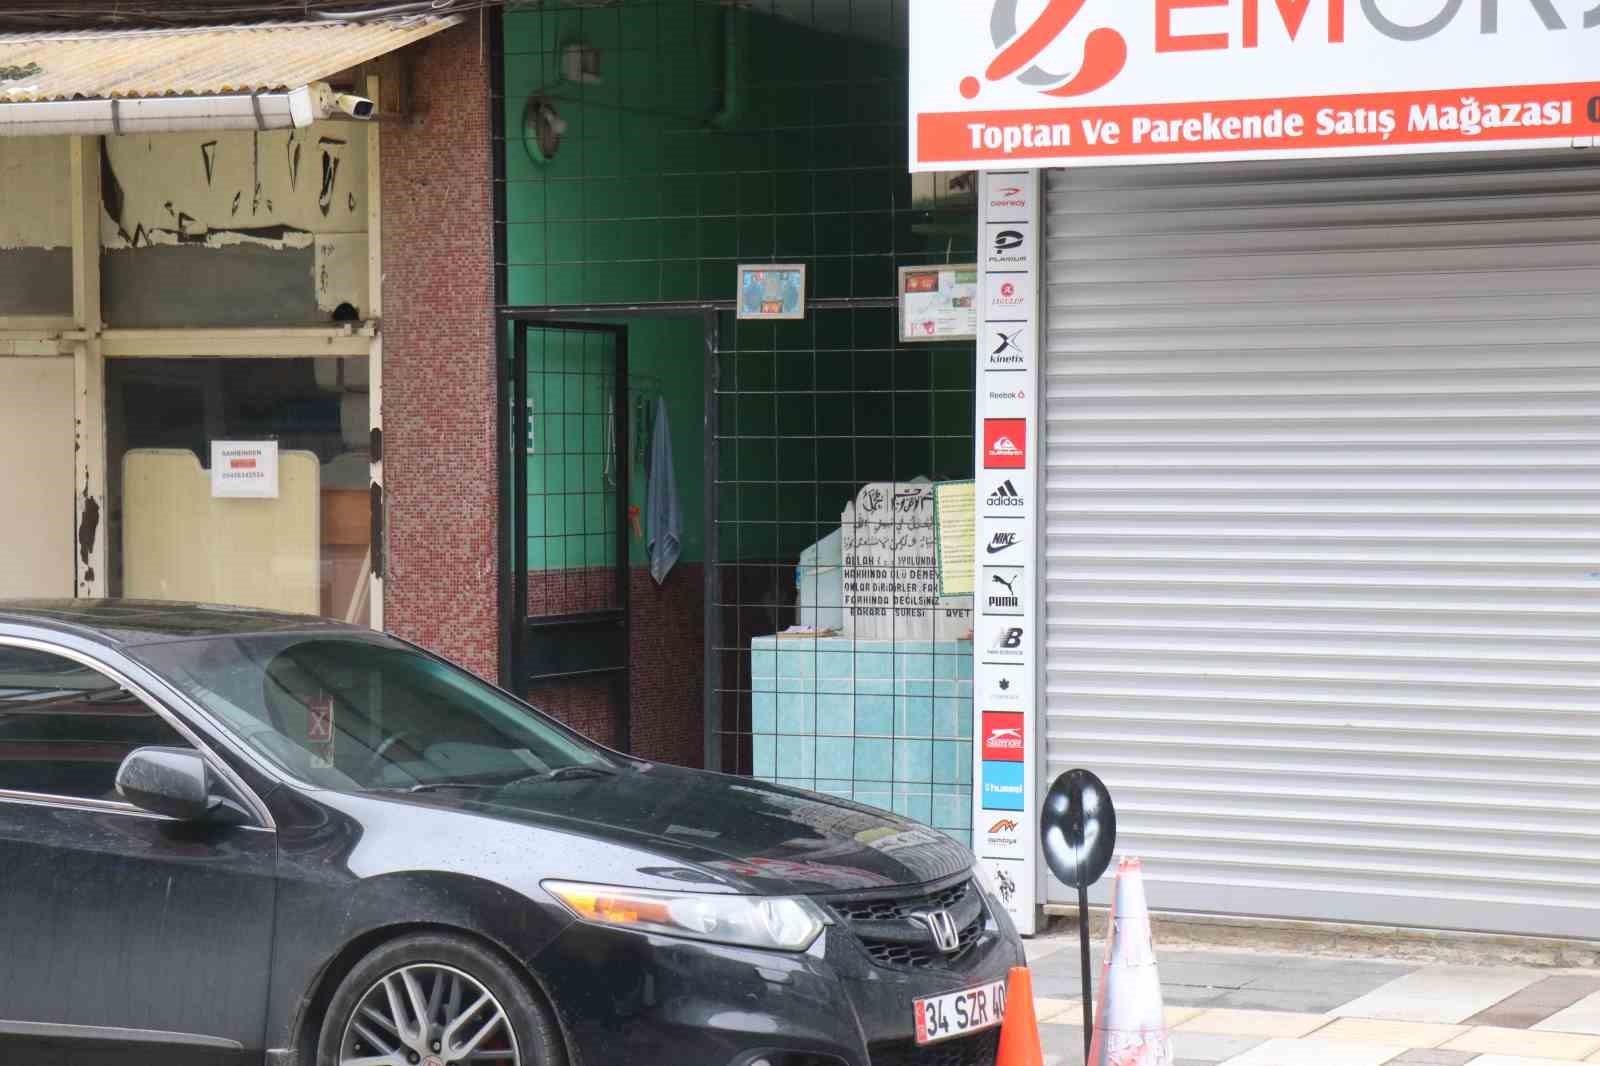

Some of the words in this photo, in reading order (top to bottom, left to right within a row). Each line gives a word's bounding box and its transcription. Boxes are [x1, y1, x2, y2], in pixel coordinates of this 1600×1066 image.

[968, 123, 1070, 152] Toptan
[1081, 119, 1120, 145] Ve
[1132, 109, 1304, 144] Parekende
[1316, 107, 1396, 141] Satış
[1407, 96, 1573, 135] Mağazası
[990, 354, 1024, 363] kinetix
[986, 496, 1024, 506] adidas
[991, 532, 1017, 545] NIKE
[988, 596, 1018, 608] PUMA
[925, 999, 949, 1037] 34
[954, 990, 988, 1029] SZR
[992, 982, 1008, 1019] 40
